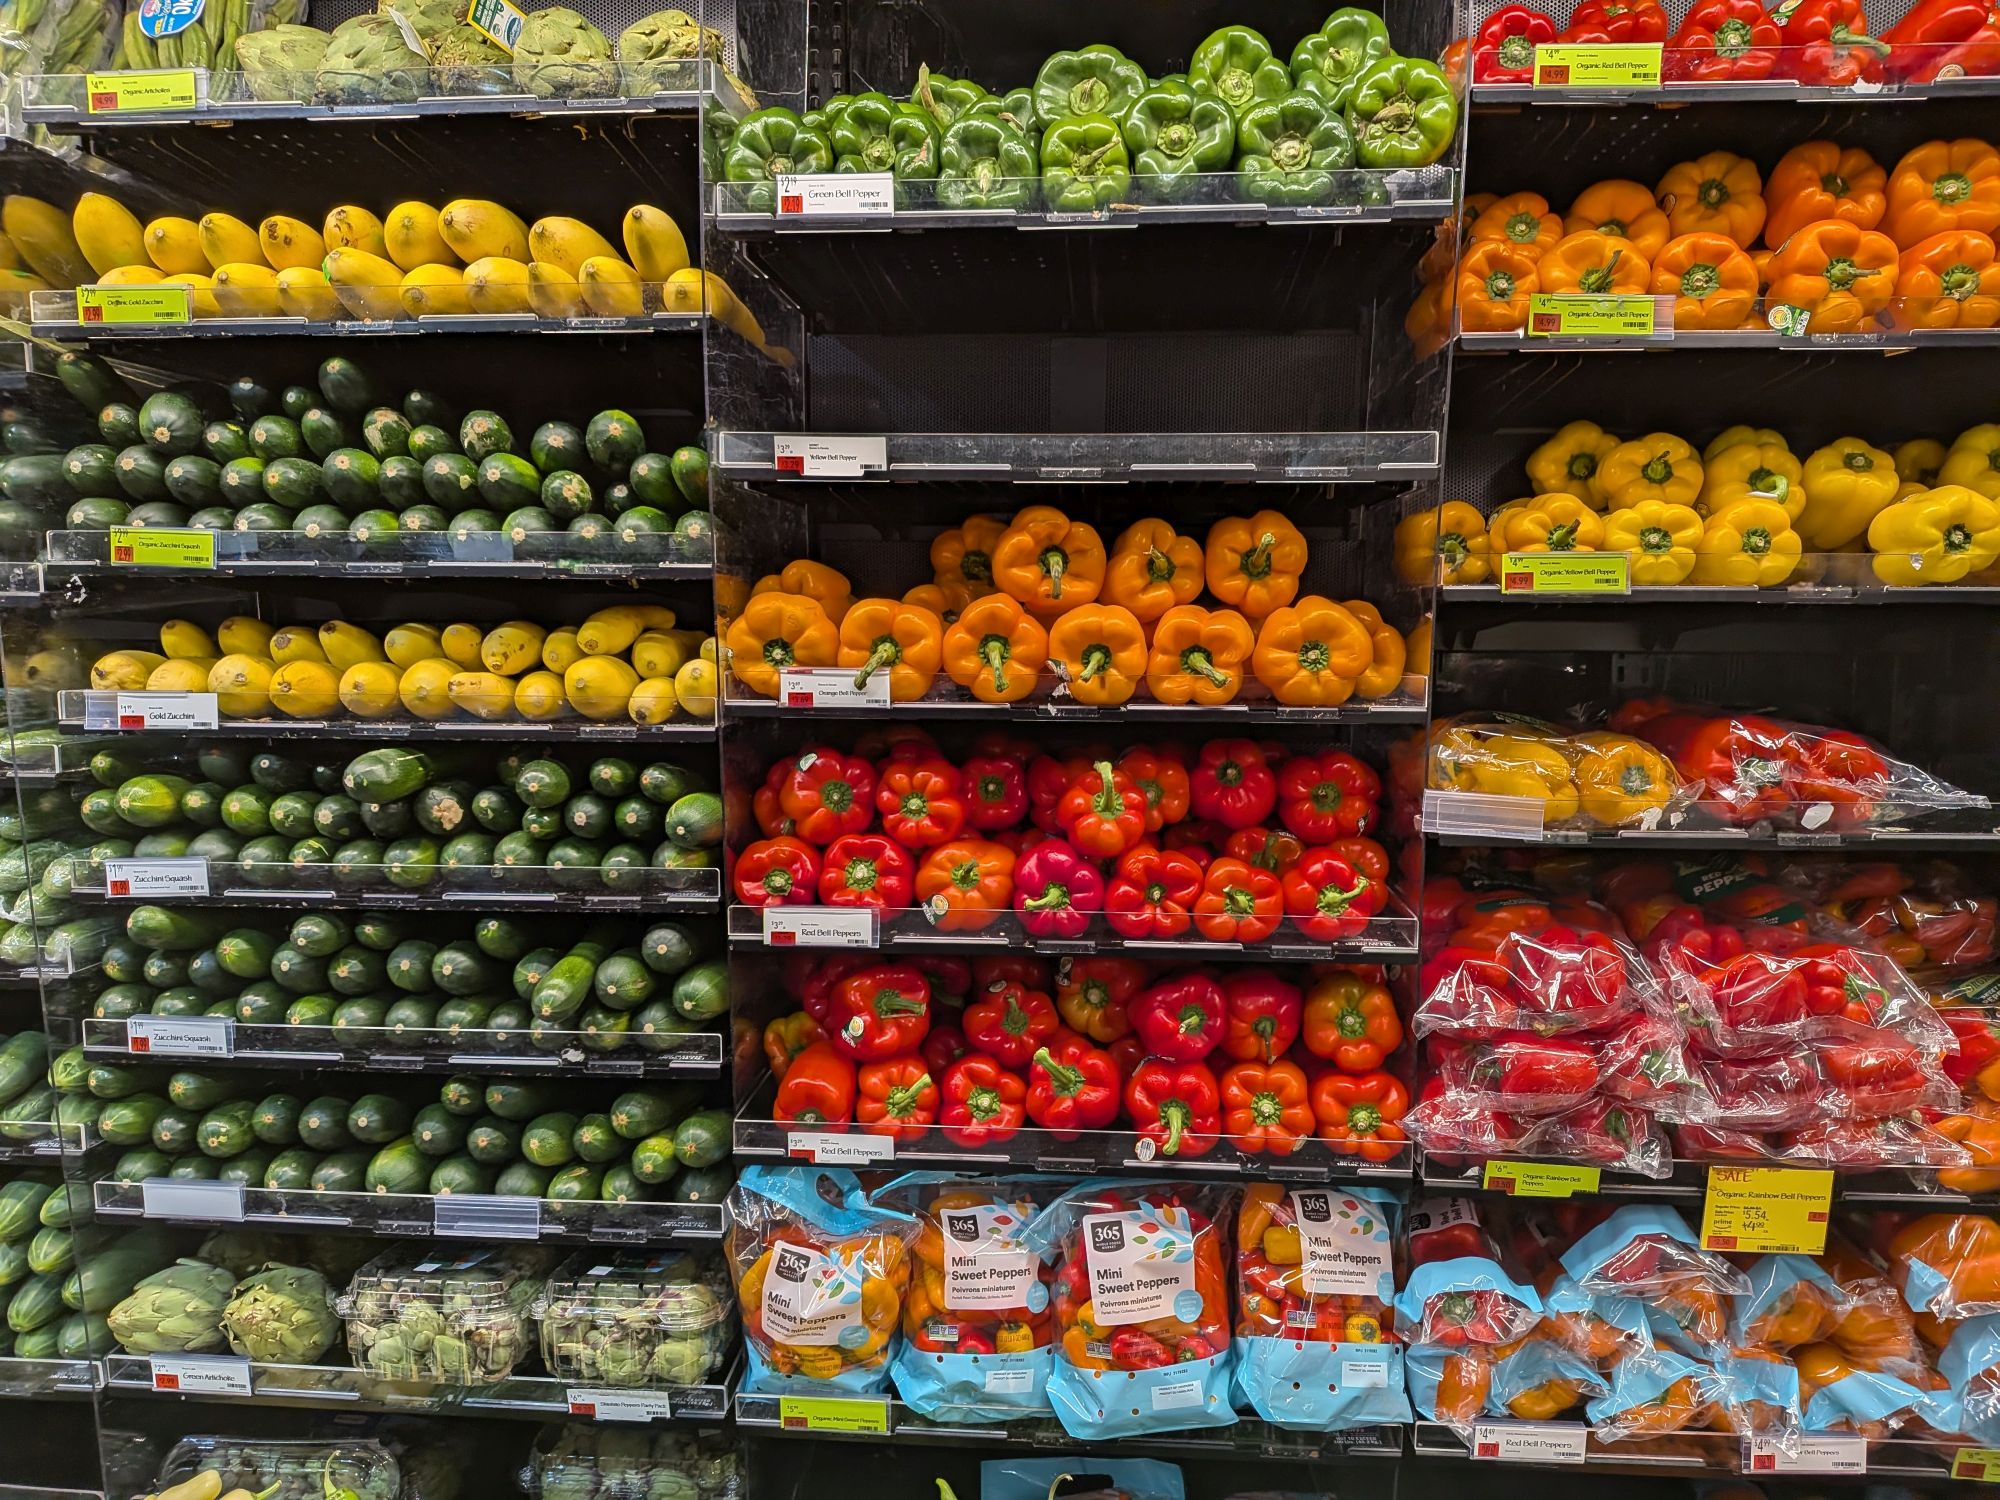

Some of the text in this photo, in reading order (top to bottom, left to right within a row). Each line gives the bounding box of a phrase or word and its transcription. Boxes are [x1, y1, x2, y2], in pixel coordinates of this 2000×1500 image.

[1576, 62, 1600, 70] Organic
[1627, 62, 1649, 70] Pepper
[808, 190, 881, 199] Green Bell Pepper
[1567, 311, 1592, 319] Organic
[1592, 311, 1616, 319] Orange
[1628, 311, 1649, 319] Pepper
[138, 541, 159, 549] Organic
[1539, 569, 1564, 577] Organic
[149, 712, 195, 720] Gold Zucchini
[134, 874, 193, 884] Zucchini Squash
[801, 928, 862, 938] Red Bell Peppers
[153, 1033, 211, 1044] Zucchini Squash
[821, 1147, 883, 1157] Red Bell Peppers
[1522, 1173, 1546, 1181] Organic
[1716, 1170, 1752, 1183] SALE
[1716, 1190, 1827, 1202] Organic Rainbow Bell Peppers
[1304, 1197, 1326, 1212] 365
[951, 1219, 975, 1232] 365
[1094, 1224, 1121, 1242] 365
[1309, 1236, 1332, 1248] Mini
[780, 1252, 807, 1274] 365
[951, 1256, 977, 1267] Mini
[1309, 1250, 1382, 1266] Sweet Peppers
[951, 1267, 1031, 1281] Sweet Peppers
[1096, 1267, 1123, 1281] Mini
[1337, 1268, 1367, 1277] miniatures
[951, 1285, 1016, 1294] Poivrons miniatures
[1098, 1276, 1180, 1295] Sweet Peppers
[767, 1291, 792, 1309] Mini
[1100, 1294, 1162, 1309] Poivrons miniatures
[767, 1303, 847, 1326] Sweet Peppers
[766, 1316, 790, 1333] Poivrons
[183, 1372, 236, 1382] Green Artichoke
[1505, 1438, 1522, 1447] Red
[1539, 1440, 1573, 1449] Peppers
